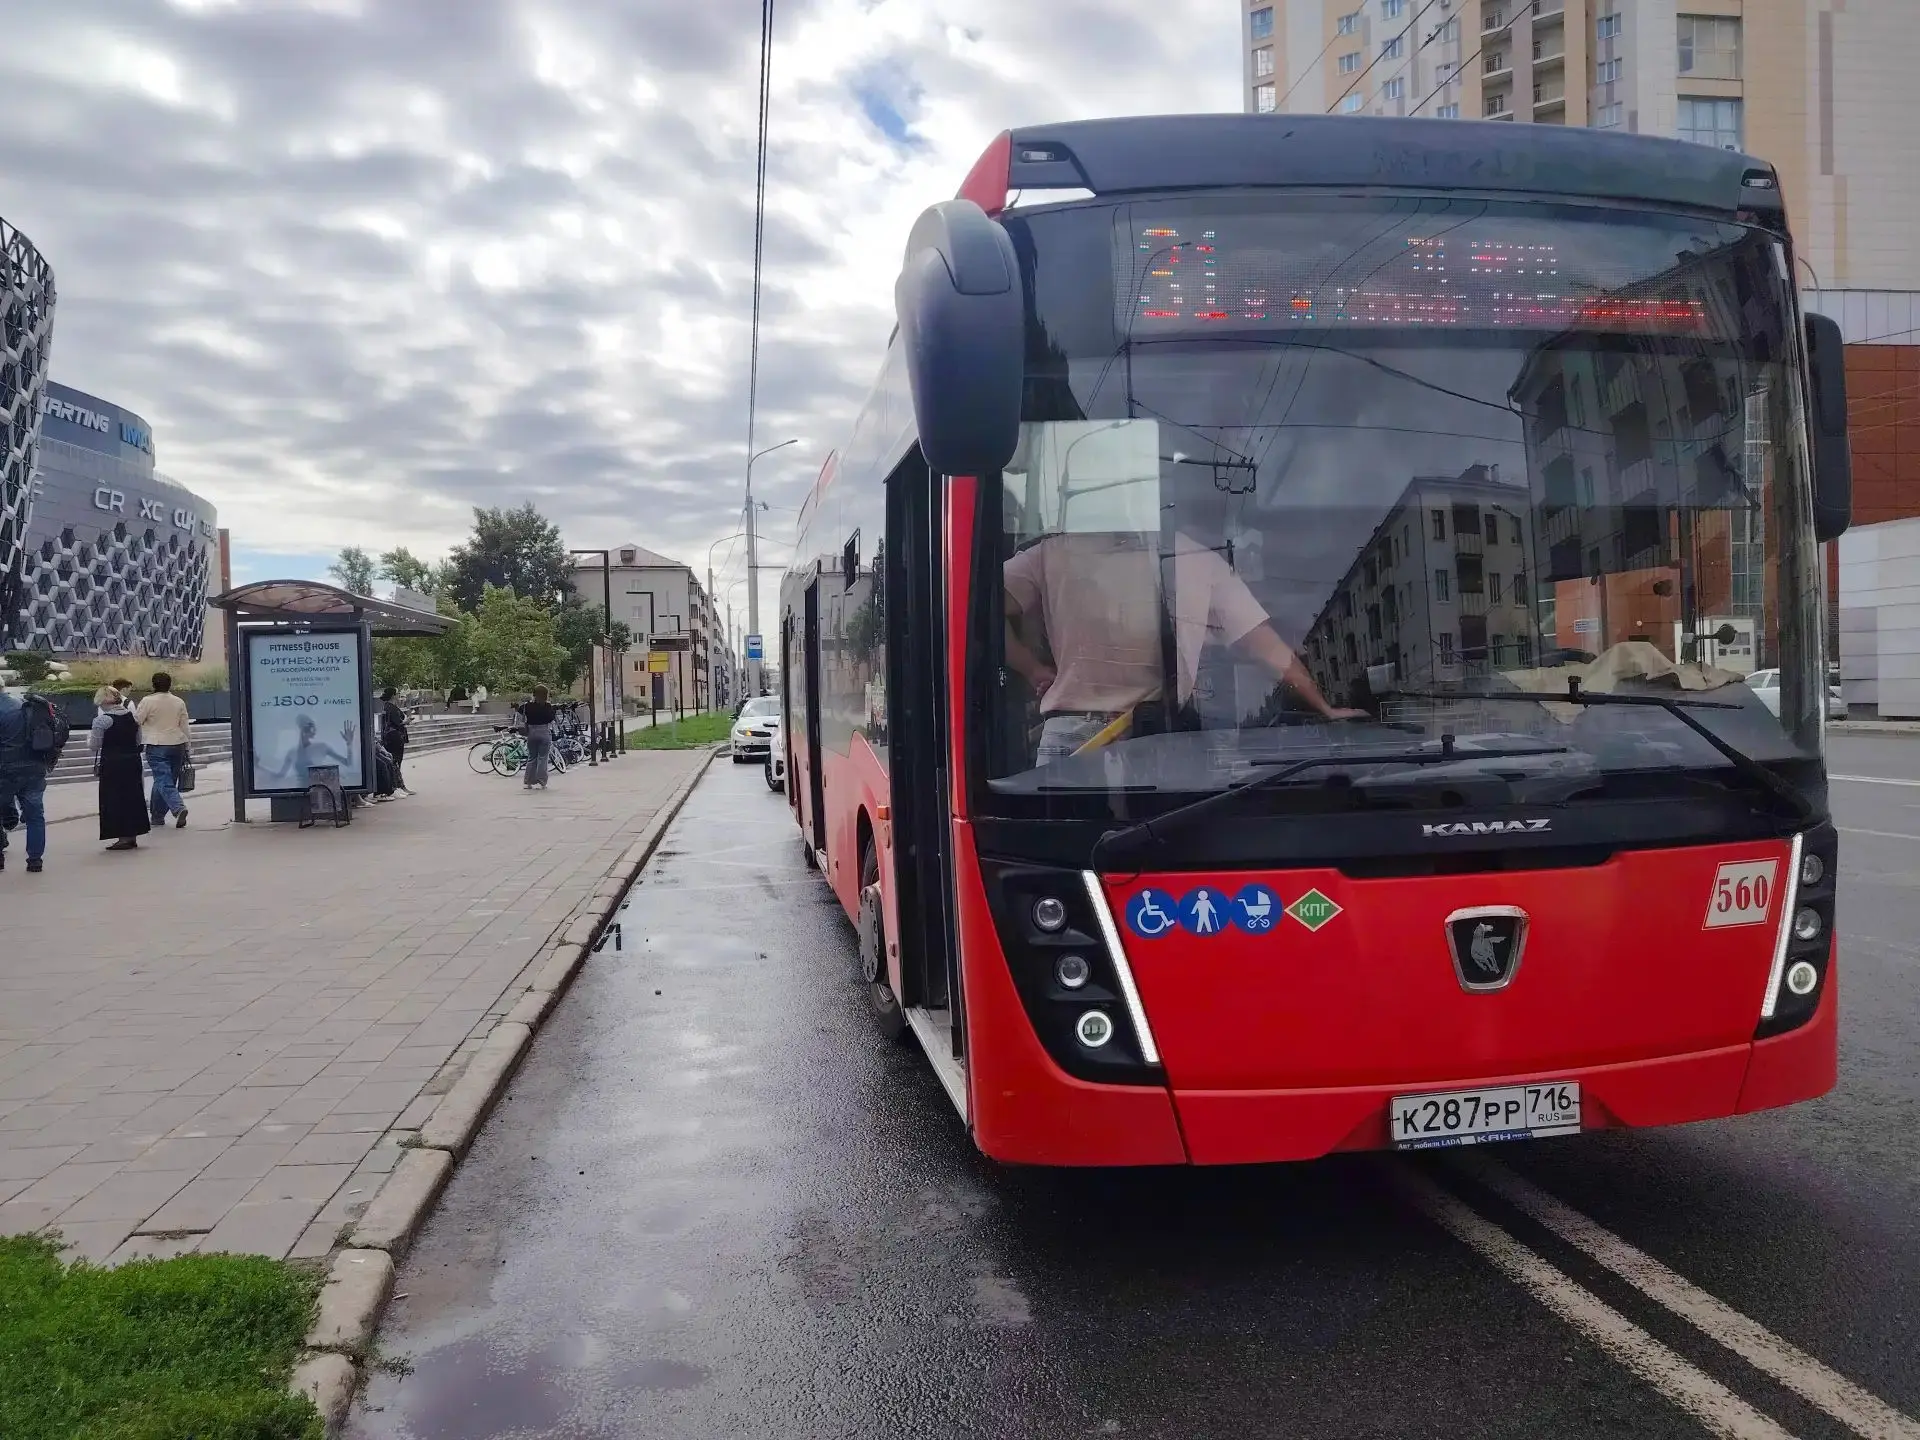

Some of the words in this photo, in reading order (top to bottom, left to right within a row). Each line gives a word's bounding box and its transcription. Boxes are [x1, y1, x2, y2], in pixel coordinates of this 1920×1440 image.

[269, 644, 303, 652] FITNESS
[312, 642, 340, 650] HOUSE
[260, 656, 351, 665] ФИТНЕС-КЛУБ
[273, 694, 319, 707] 1800
[1422, 819, 1552, 837] KAMAZ
[1716, 874, 1768, 913] 560
[1299, 903, 1330, 917] КПГ
[1527, 1086, 1572, 1113] 716
[1538, 1112, 1560, 1123] RUS
